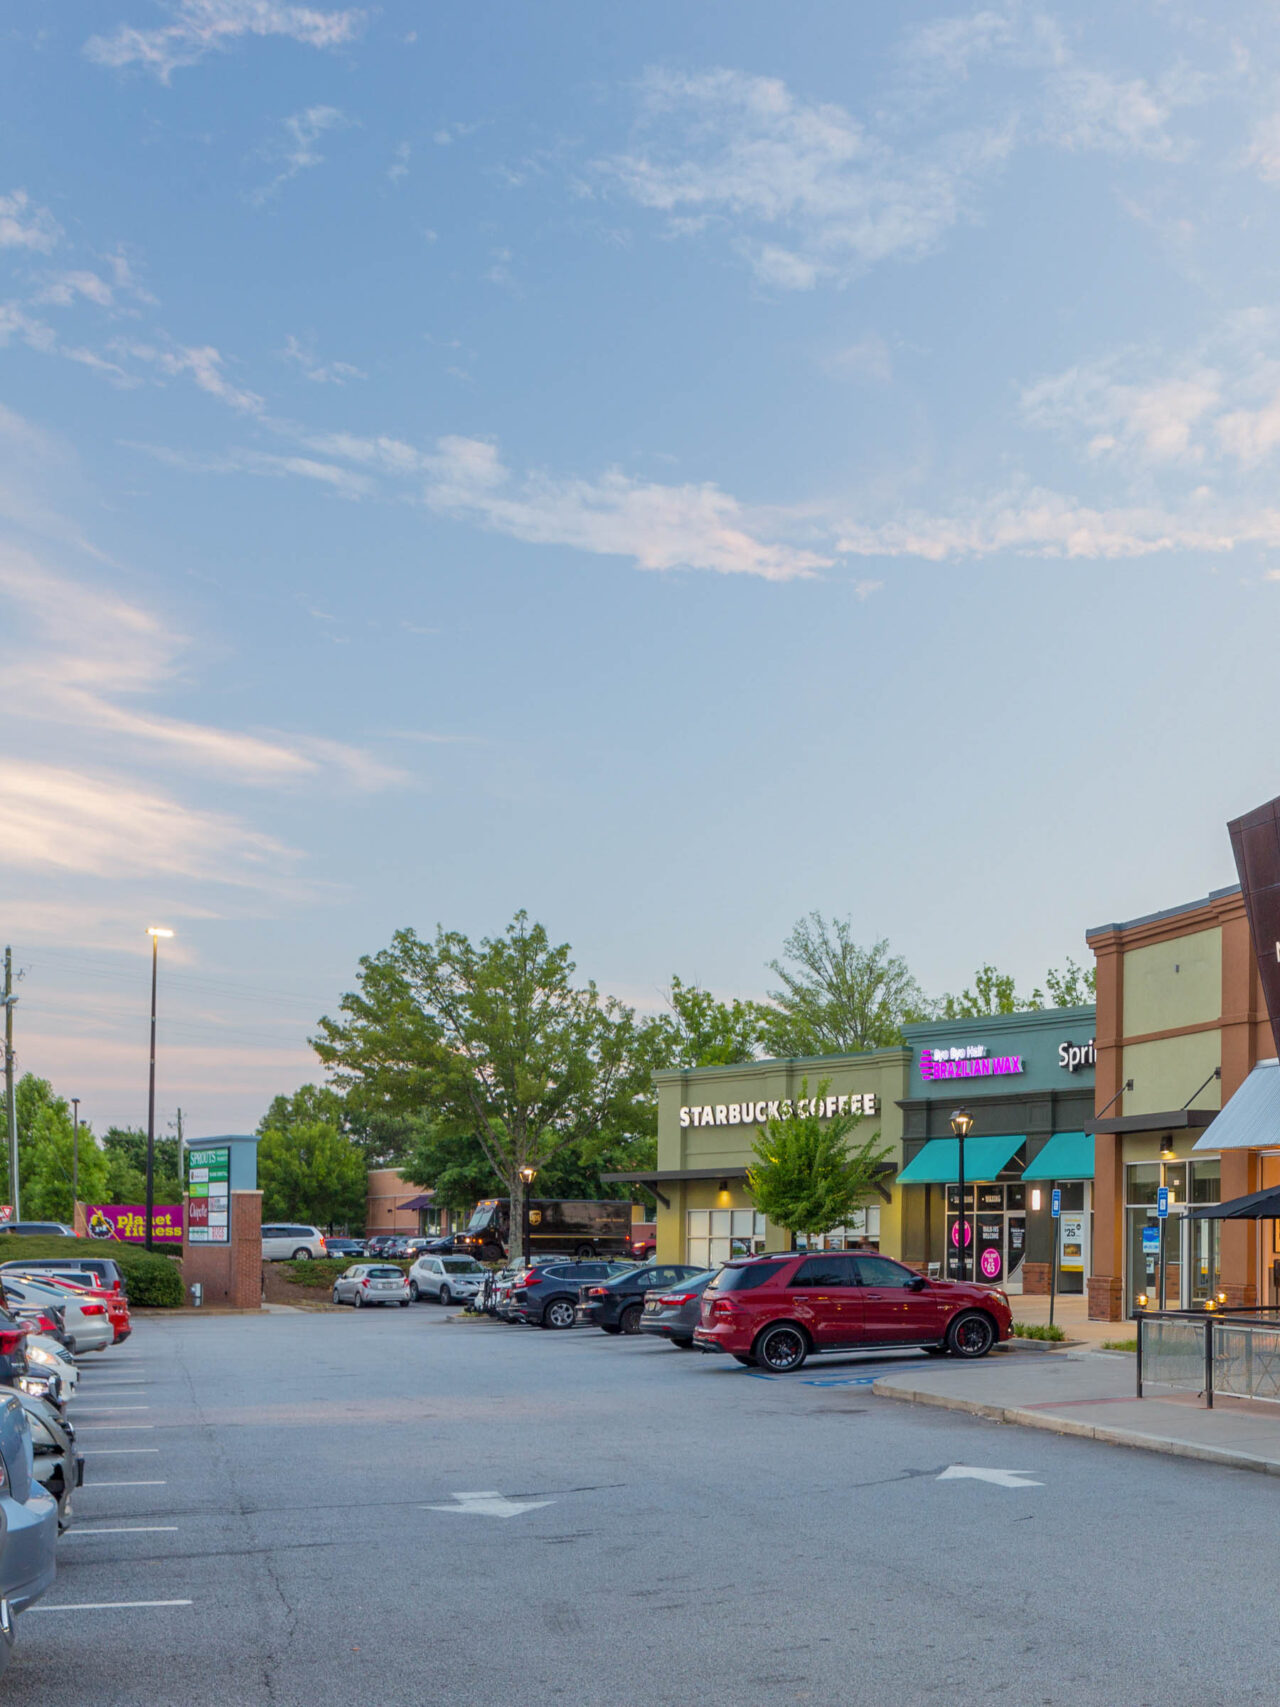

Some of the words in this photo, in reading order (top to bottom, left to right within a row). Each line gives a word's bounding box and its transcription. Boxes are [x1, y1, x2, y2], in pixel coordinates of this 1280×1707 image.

[1058, 1040, 1097, 1072] Spri
[933, 1058, 991, 1080] BRAZILIAN
[992, 1056, 1021, 1076] WAX
[680, 1099, 793, 1127] STARBUCKS
[797, 1093, 876, 1120] COFFEE
[189, 1151, 216, 1167] SPROUTS
[117, 1213, 171, 1229] plaet
[124, 1224, 182, 1237] fitess
